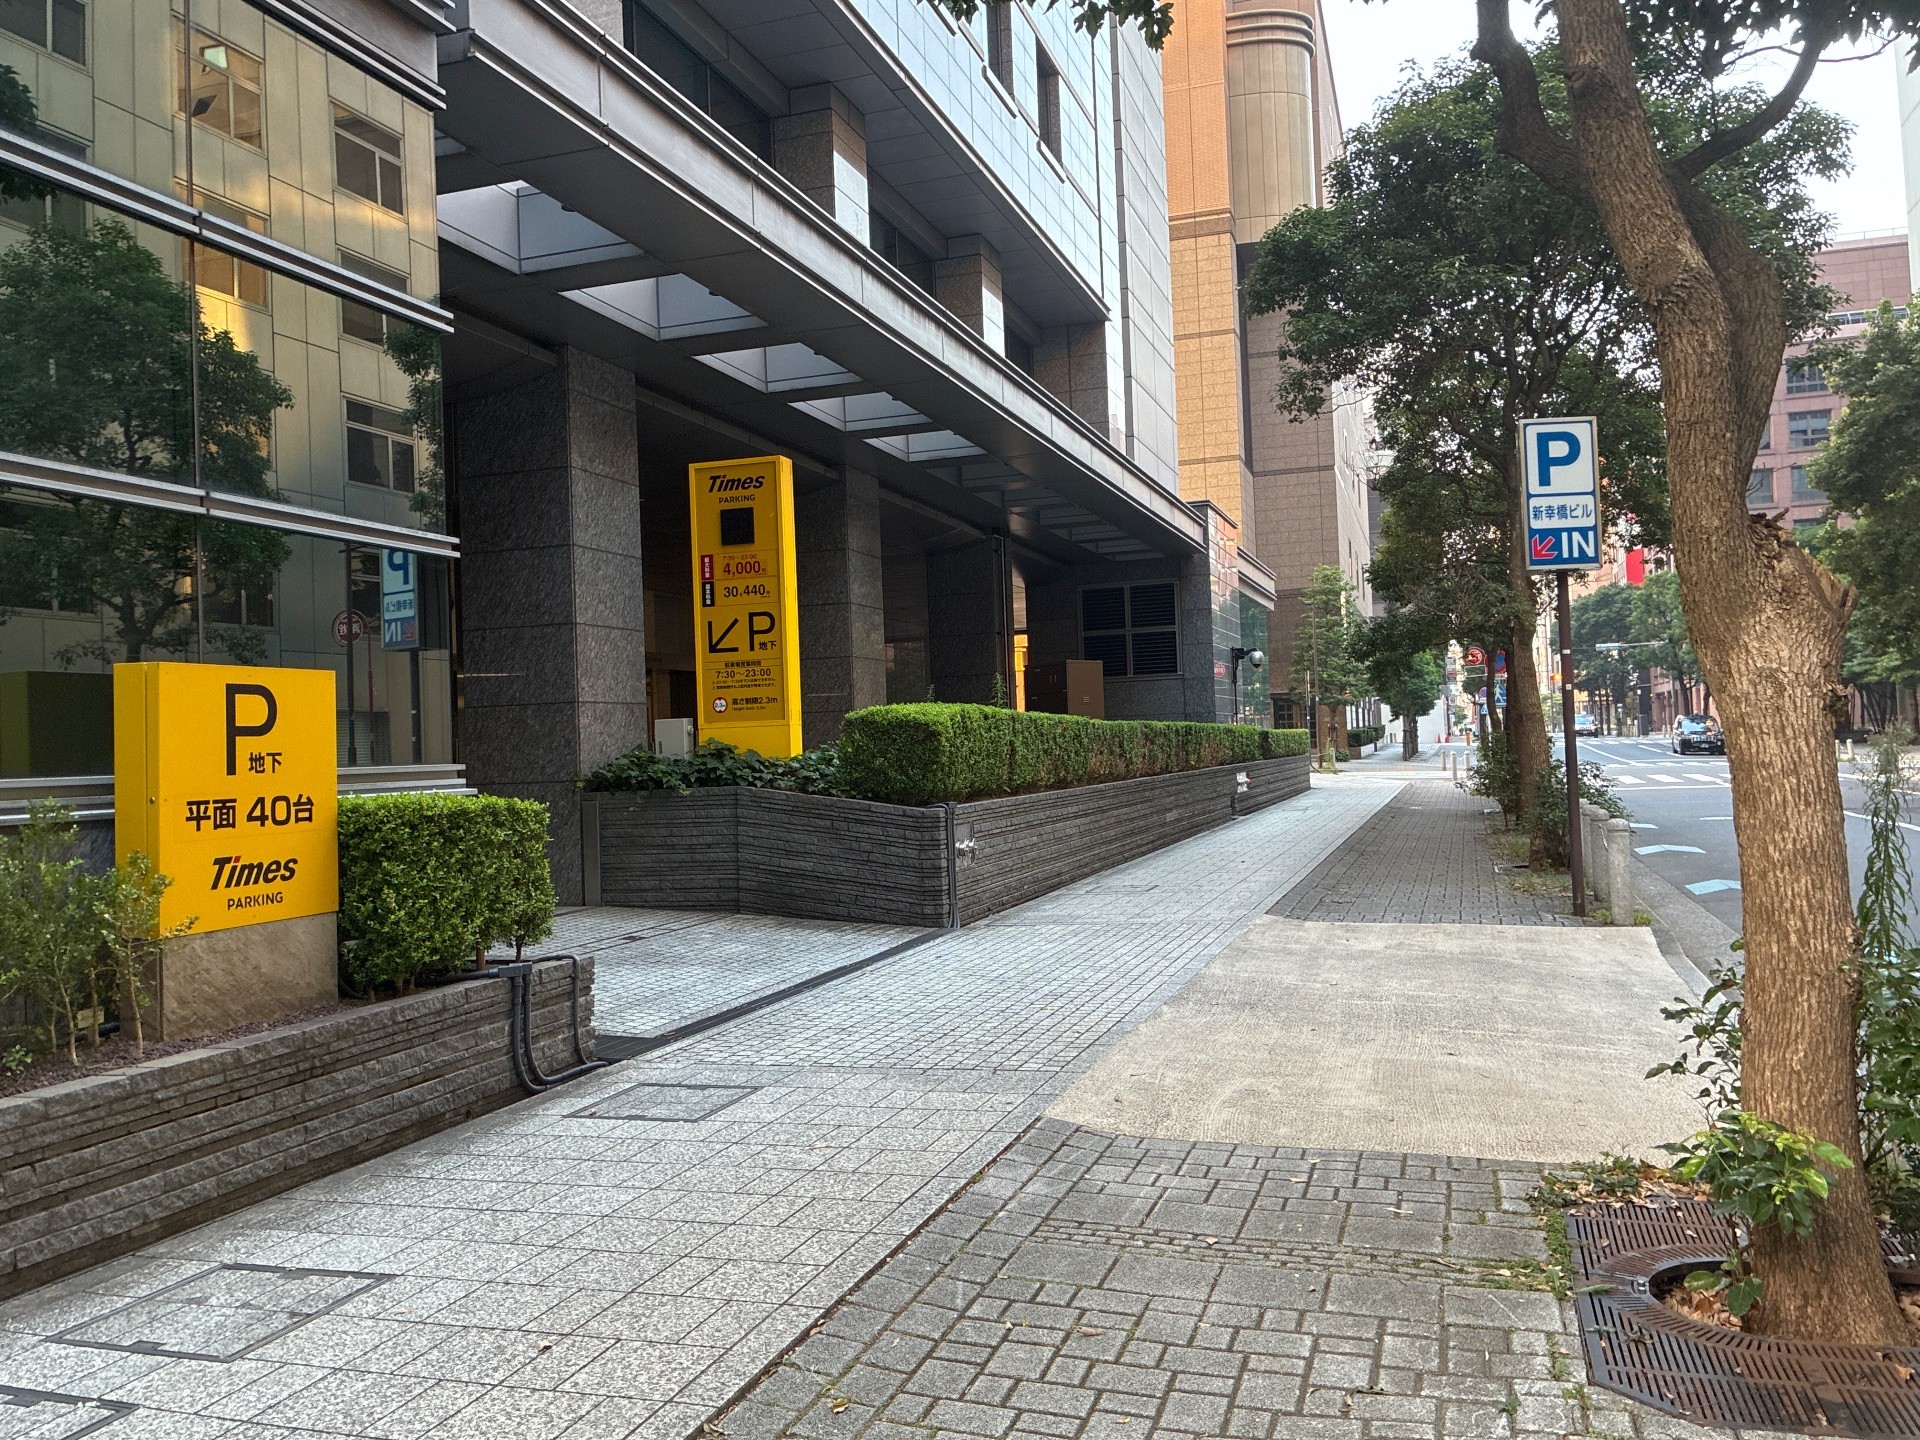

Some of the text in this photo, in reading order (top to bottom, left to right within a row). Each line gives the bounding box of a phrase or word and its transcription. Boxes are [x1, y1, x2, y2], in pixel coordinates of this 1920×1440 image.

[1537, 431, 1581, 487] P
[708, 475, 766, 493] Times
[718, 494, 756, 504] PARKING
[1532, 503, 1593, 521] 新幸橋ビル
[1561, 531, 1596, 559] IN
[748, 611, 776, 652] P
[759, 641, 777, 651] 地下
[732, 696, 778, 706] 高さ制限2.3m
[225, 683, 278, 776] P
[248, 752, 283, 774] 地下
[185, 794, 315, 832] 平面 40台
[210, 856, 299, 891] Times
[227, 892, 284, 911] PARKING
